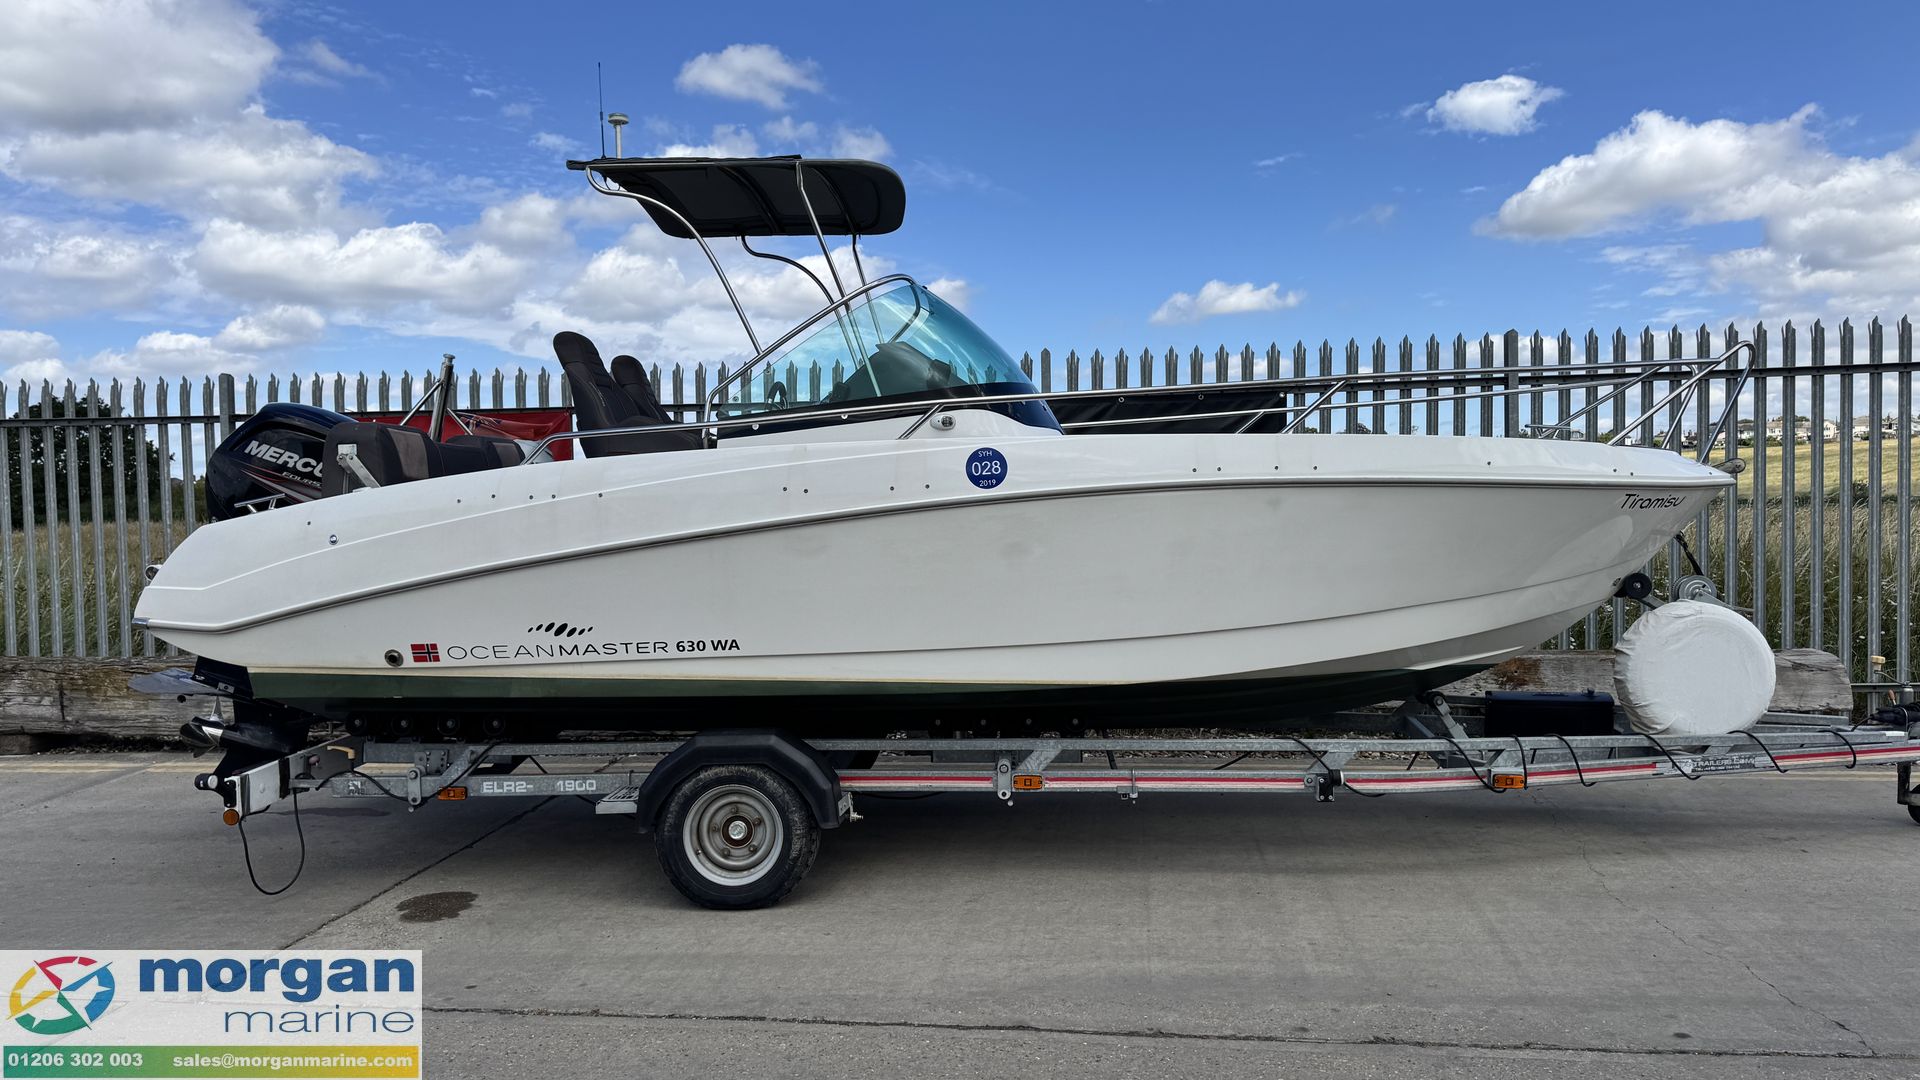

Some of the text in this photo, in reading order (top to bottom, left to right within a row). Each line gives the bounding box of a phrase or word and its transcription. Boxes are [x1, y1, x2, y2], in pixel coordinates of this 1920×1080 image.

[972, 460, 1001, 476] 028
[979, 478, 996, 487] 2019
[1621, 493, 1686, 509] Tiramisu
[447, 639, 740, 660] OCEANMASTER 630 WA
[557, 779, 597, 792] 1900
